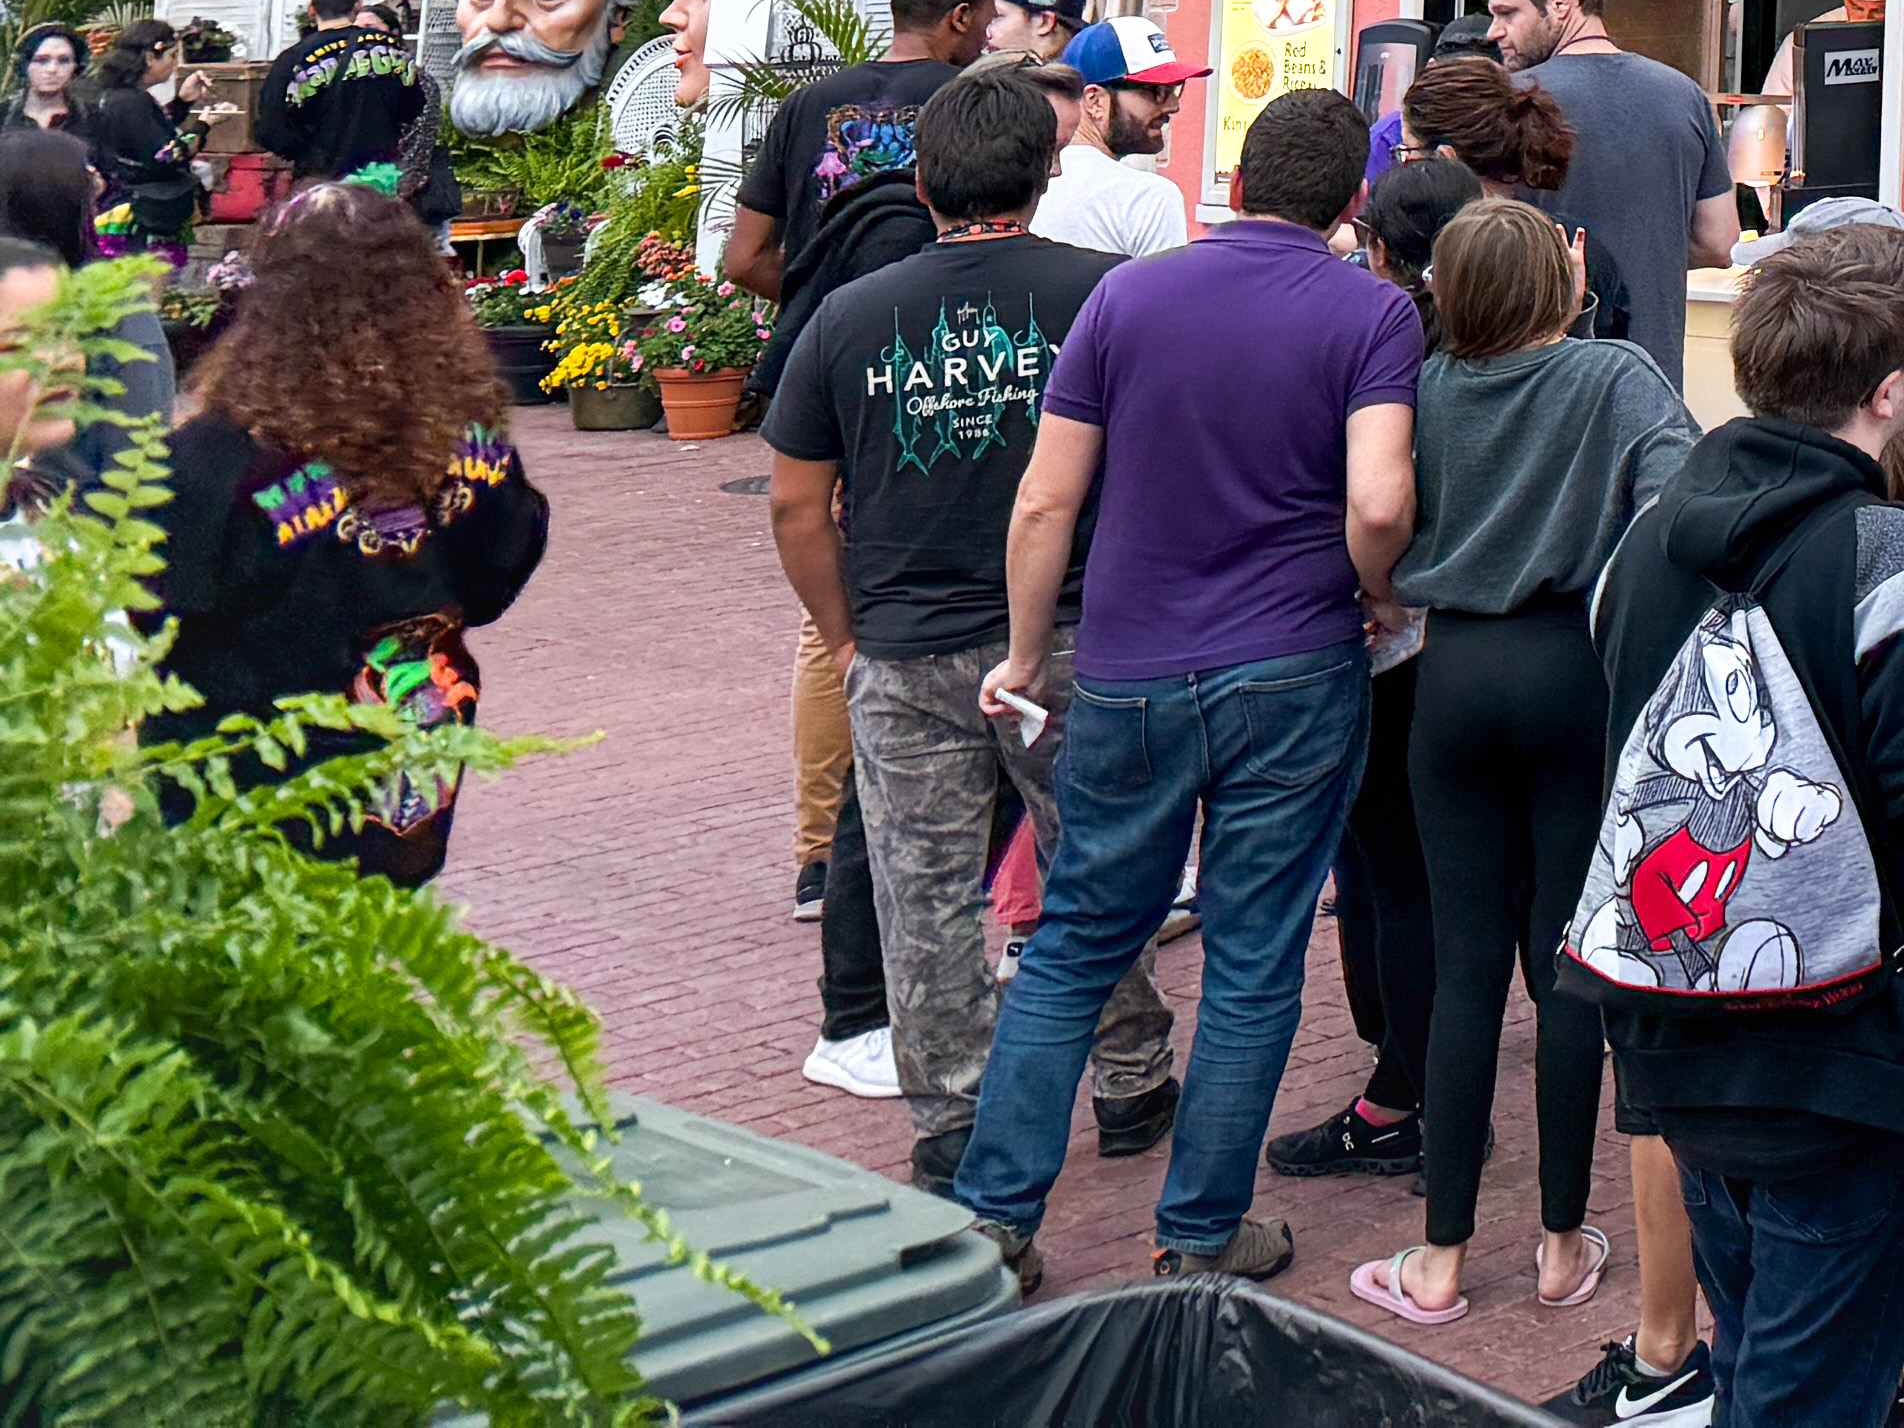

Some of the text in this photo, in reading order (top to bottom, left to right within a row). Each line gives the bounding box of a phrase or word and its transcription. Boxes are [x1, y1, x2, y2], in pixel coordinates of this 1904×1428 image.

[1284, 40, 1307, 58] Red
[1283, 59, 1327, 75] Beans &
[941, 328, 1000, 353] GUY
[906, 384, 1041, 418] Offshore Fishing
[952, 414, 993, 429] SINCE
